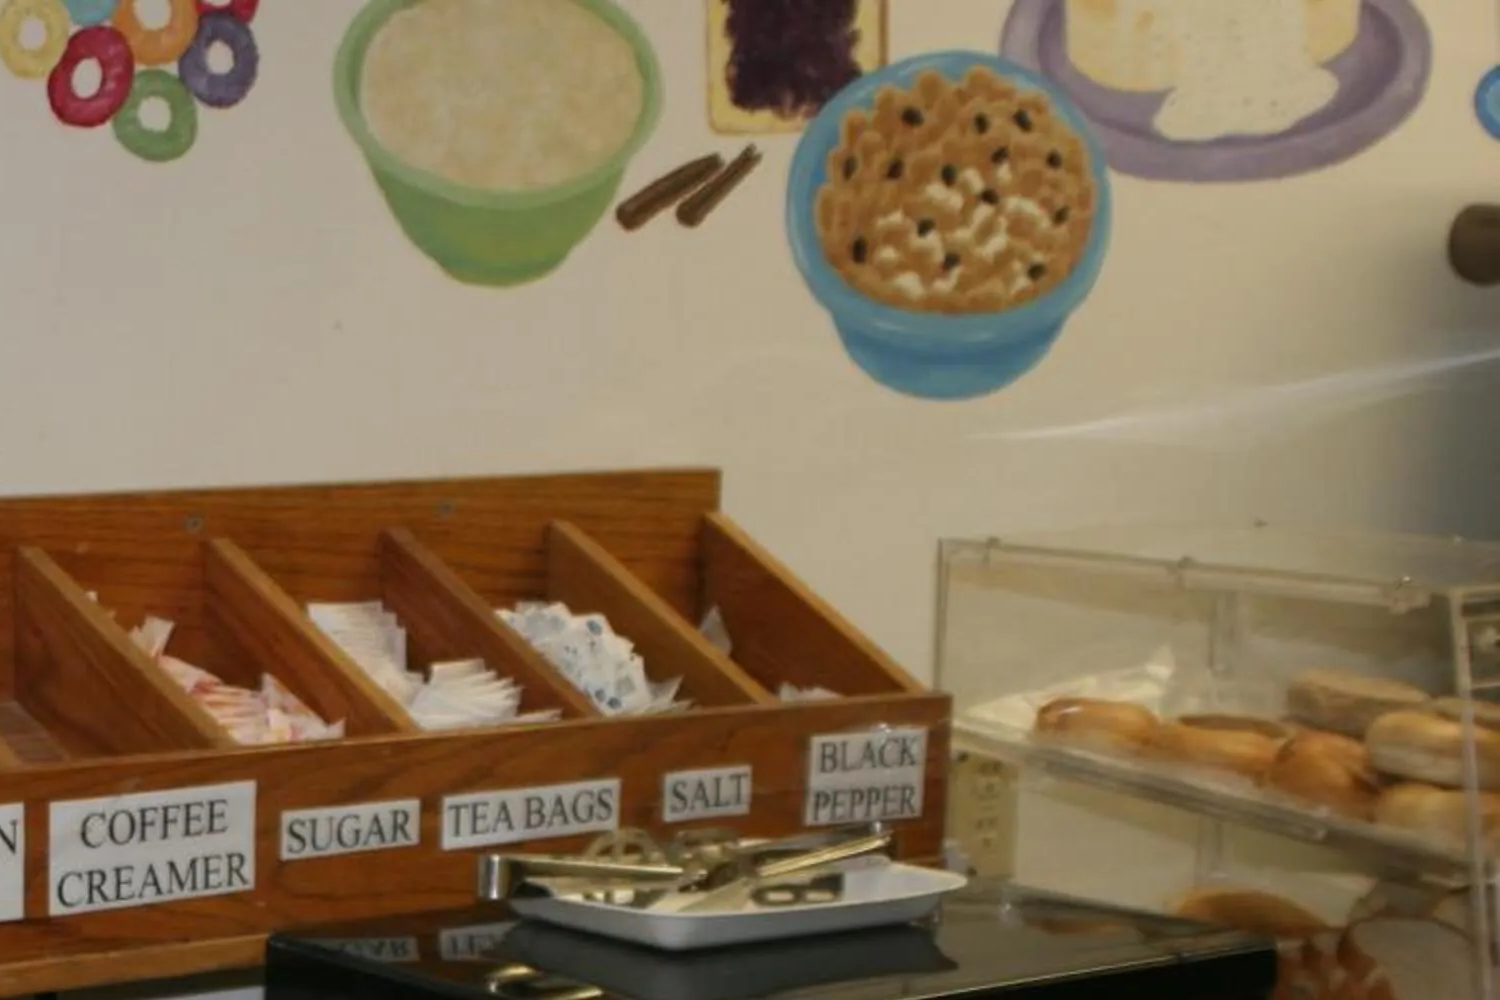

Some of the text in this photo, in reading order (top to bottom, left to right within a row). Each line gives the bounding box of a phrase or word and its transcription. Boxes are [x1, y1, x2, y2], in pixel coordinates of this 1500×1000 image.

[819, 735, 917, 773] BLACK
[448, 788, 613, 838] TEA BAGS
[670, 772, 748, 814] SALT
[813, 784, 916, 822] PEPPER
[80, 799, 229, 849] COFFEE
[286, 808, 412, 855] SUGAR
[56, 851, 250, 909] CREAMER
